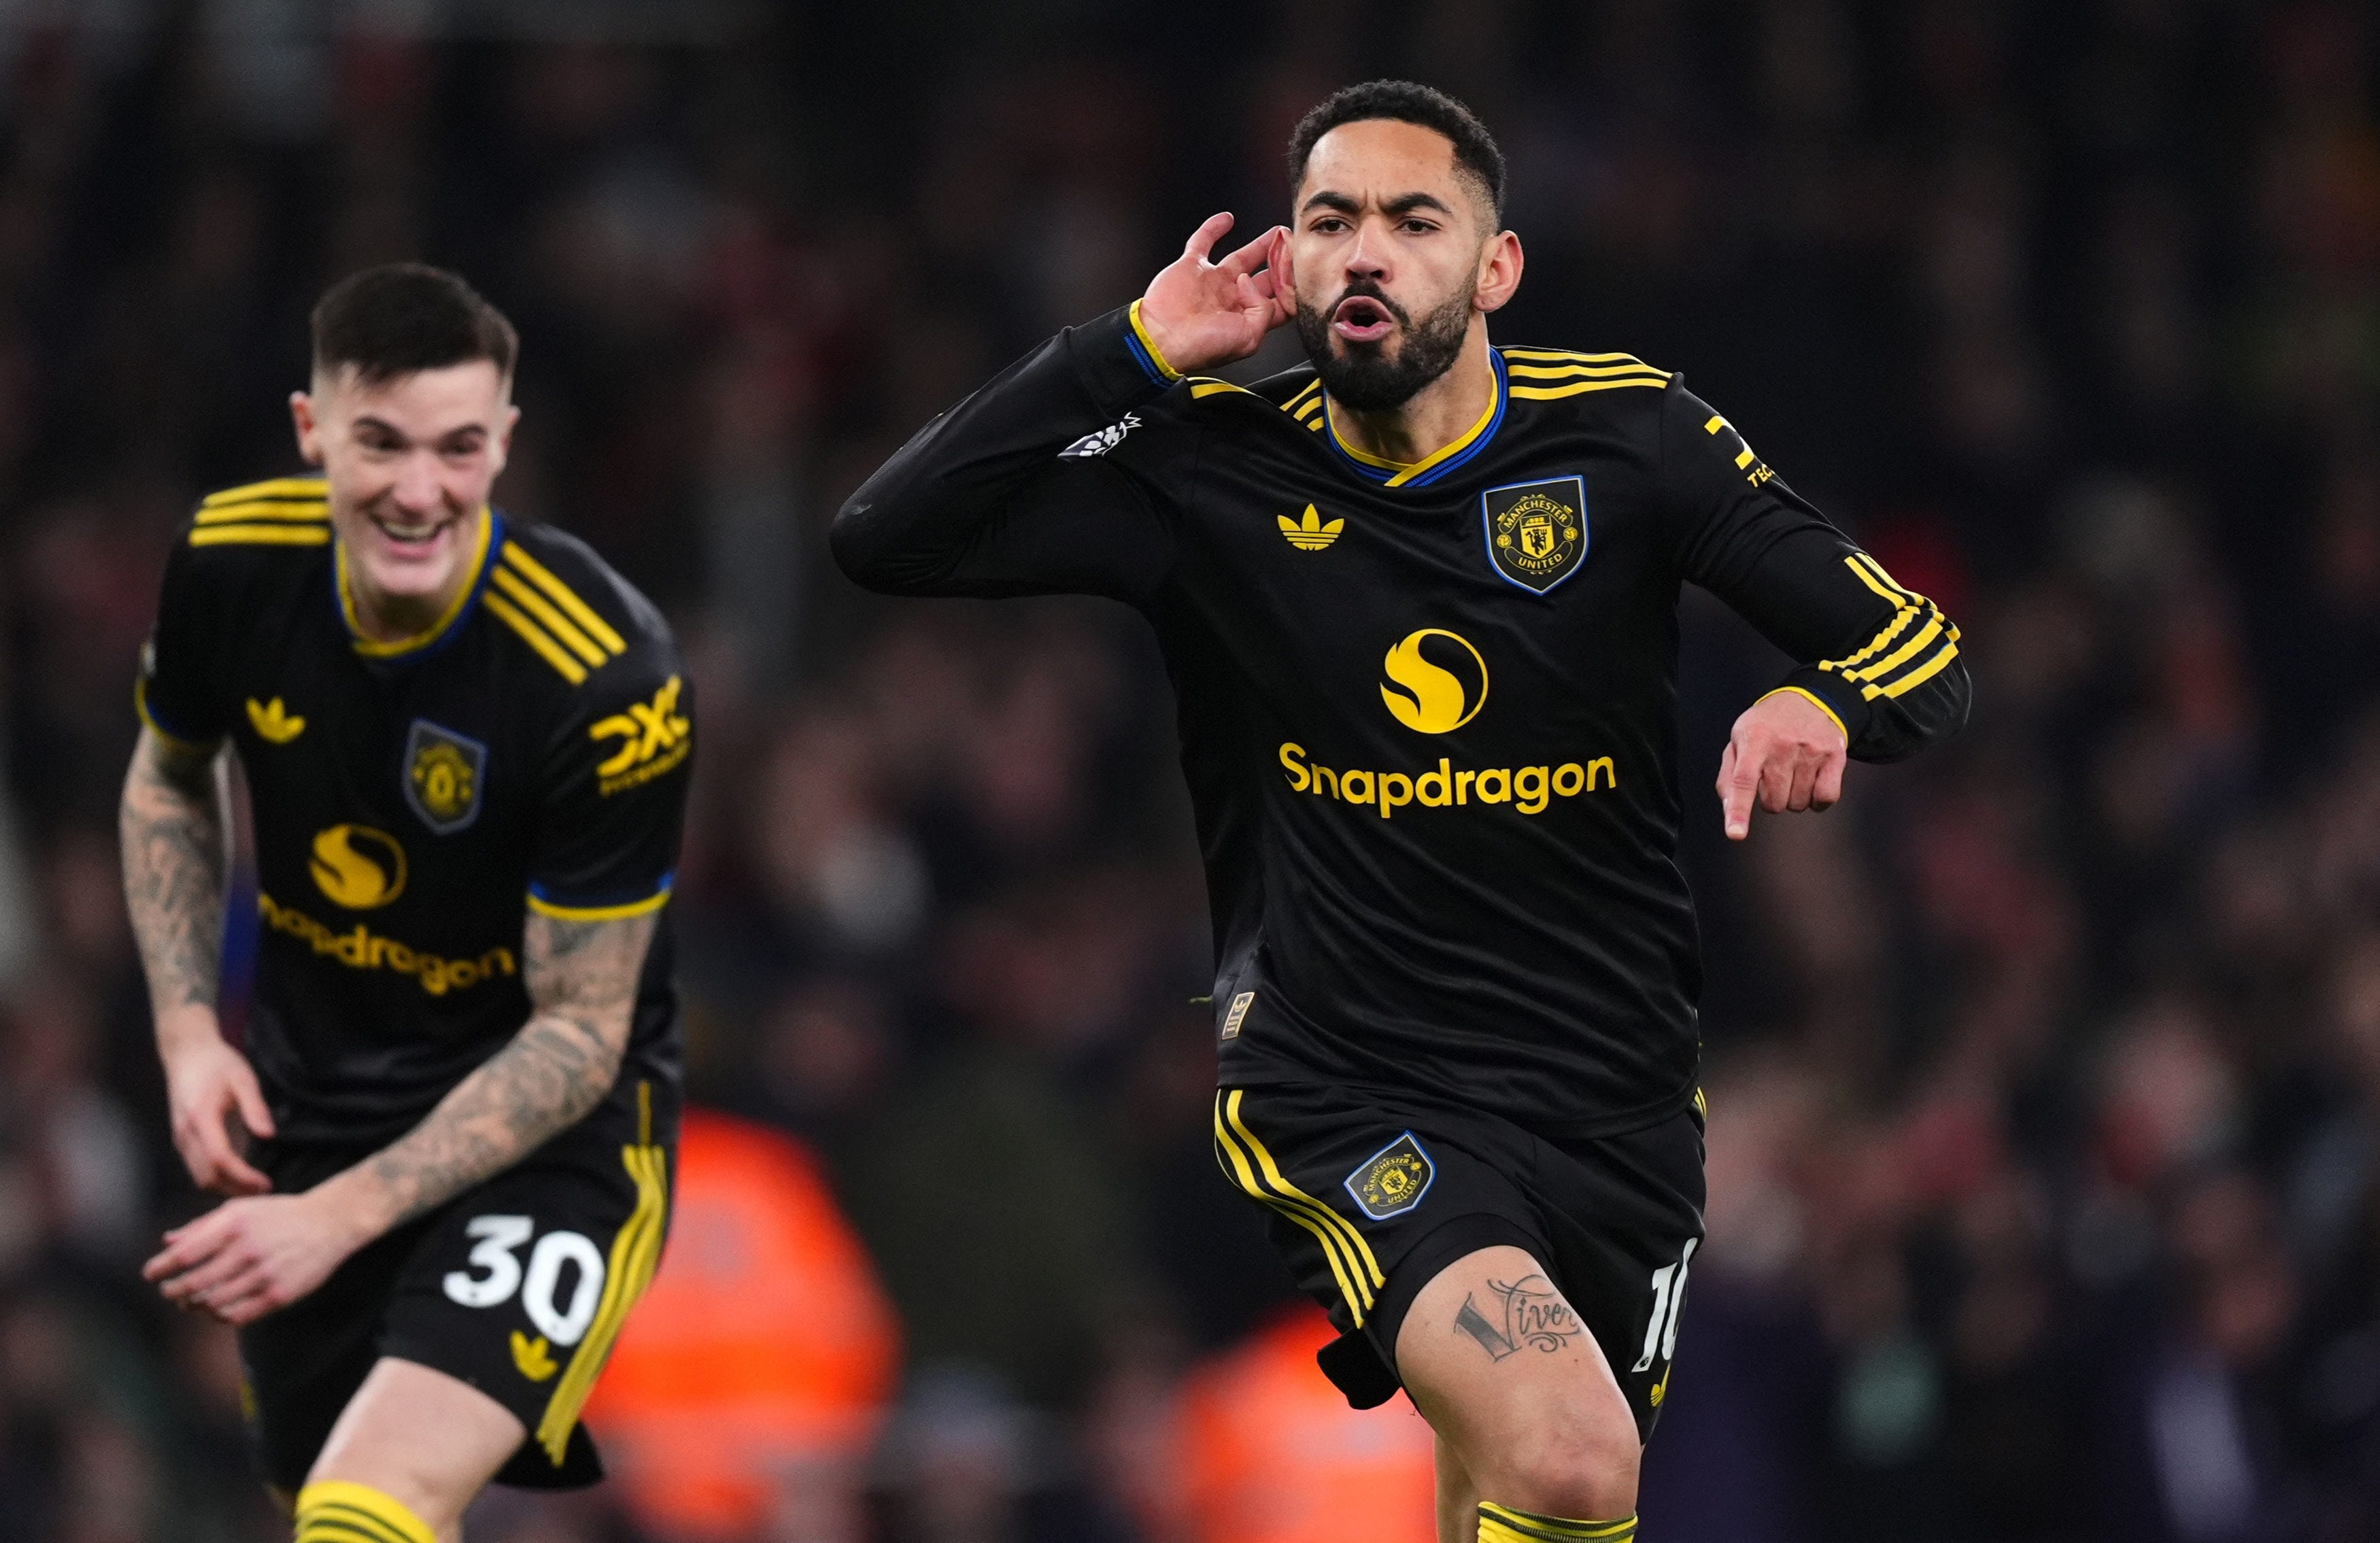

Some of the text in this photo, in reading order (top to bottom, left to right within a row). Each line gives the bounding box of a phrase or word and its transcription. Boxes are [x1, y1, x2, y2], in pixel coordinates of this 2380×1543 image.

[1747, 463, 1775, 488] TEC
[1503, 500, 1567, 528] MANCHESTER
[1518, 553, 1563, 569] UNITED
[1278, 742, 1616, 819] Snapdragon
[1368, 1157, 1410, 1191] MANCHESTER
[1387, 1180, 1417, 1204] UNITED
[443, 1213, 606, 1347] 30
